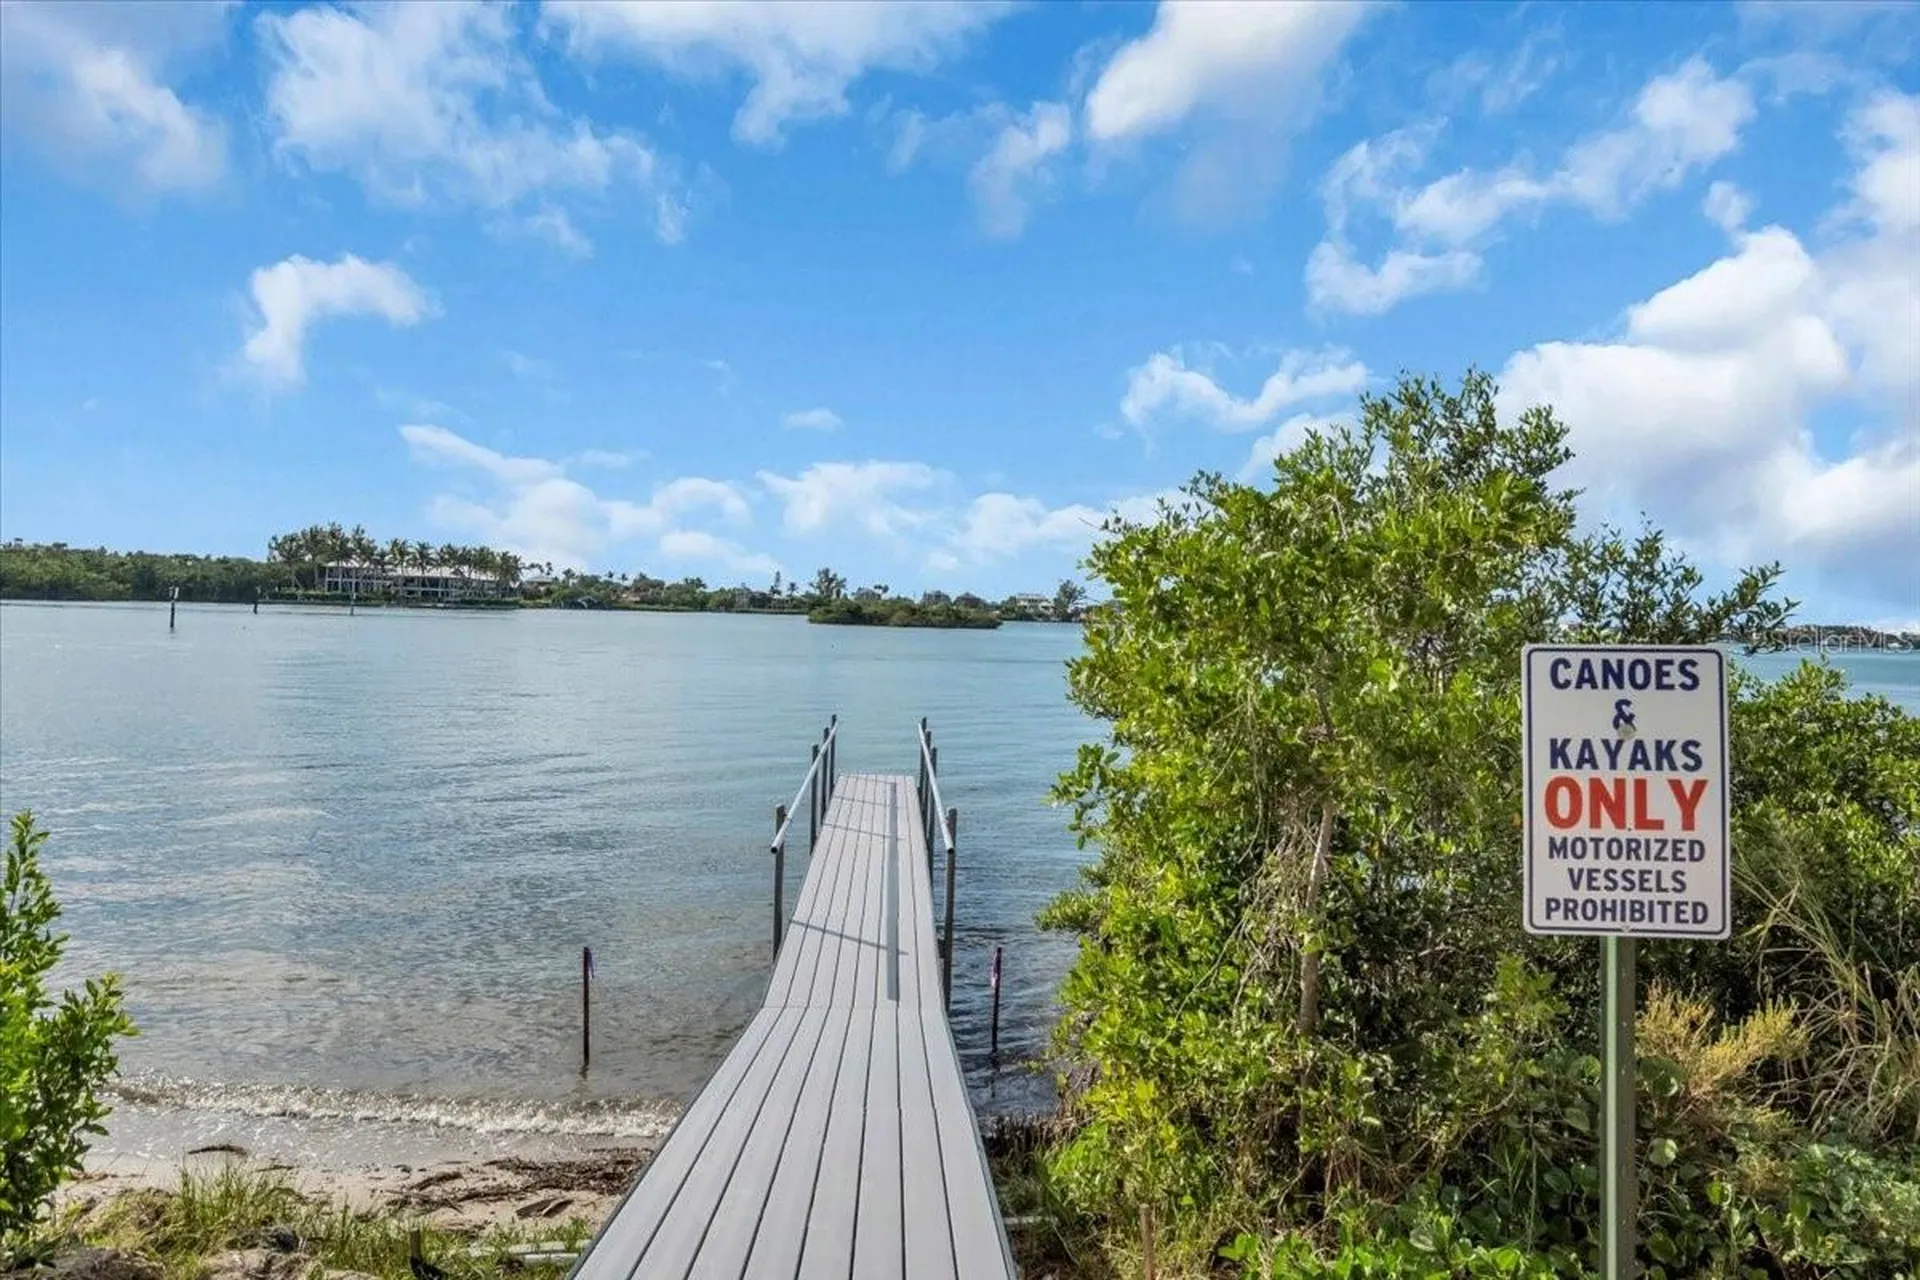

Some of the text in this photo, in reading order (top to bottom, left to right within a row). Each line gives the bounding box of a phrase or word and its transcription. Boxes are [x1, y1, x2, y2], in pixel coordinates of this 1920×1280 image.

[1550, 658, 1700, 691] CANOES
[1613, 699, 1637, 732] &
[1550, 738, 1703, 772] KAYAKS
[1545, 776, 1709, 832] ONLY
[1548, 836, 1706, 862] MOTORIZED
[1567, 867, 1687, 893] VESSELS
[1545, 898, 1709, 924] PROHIBITED
